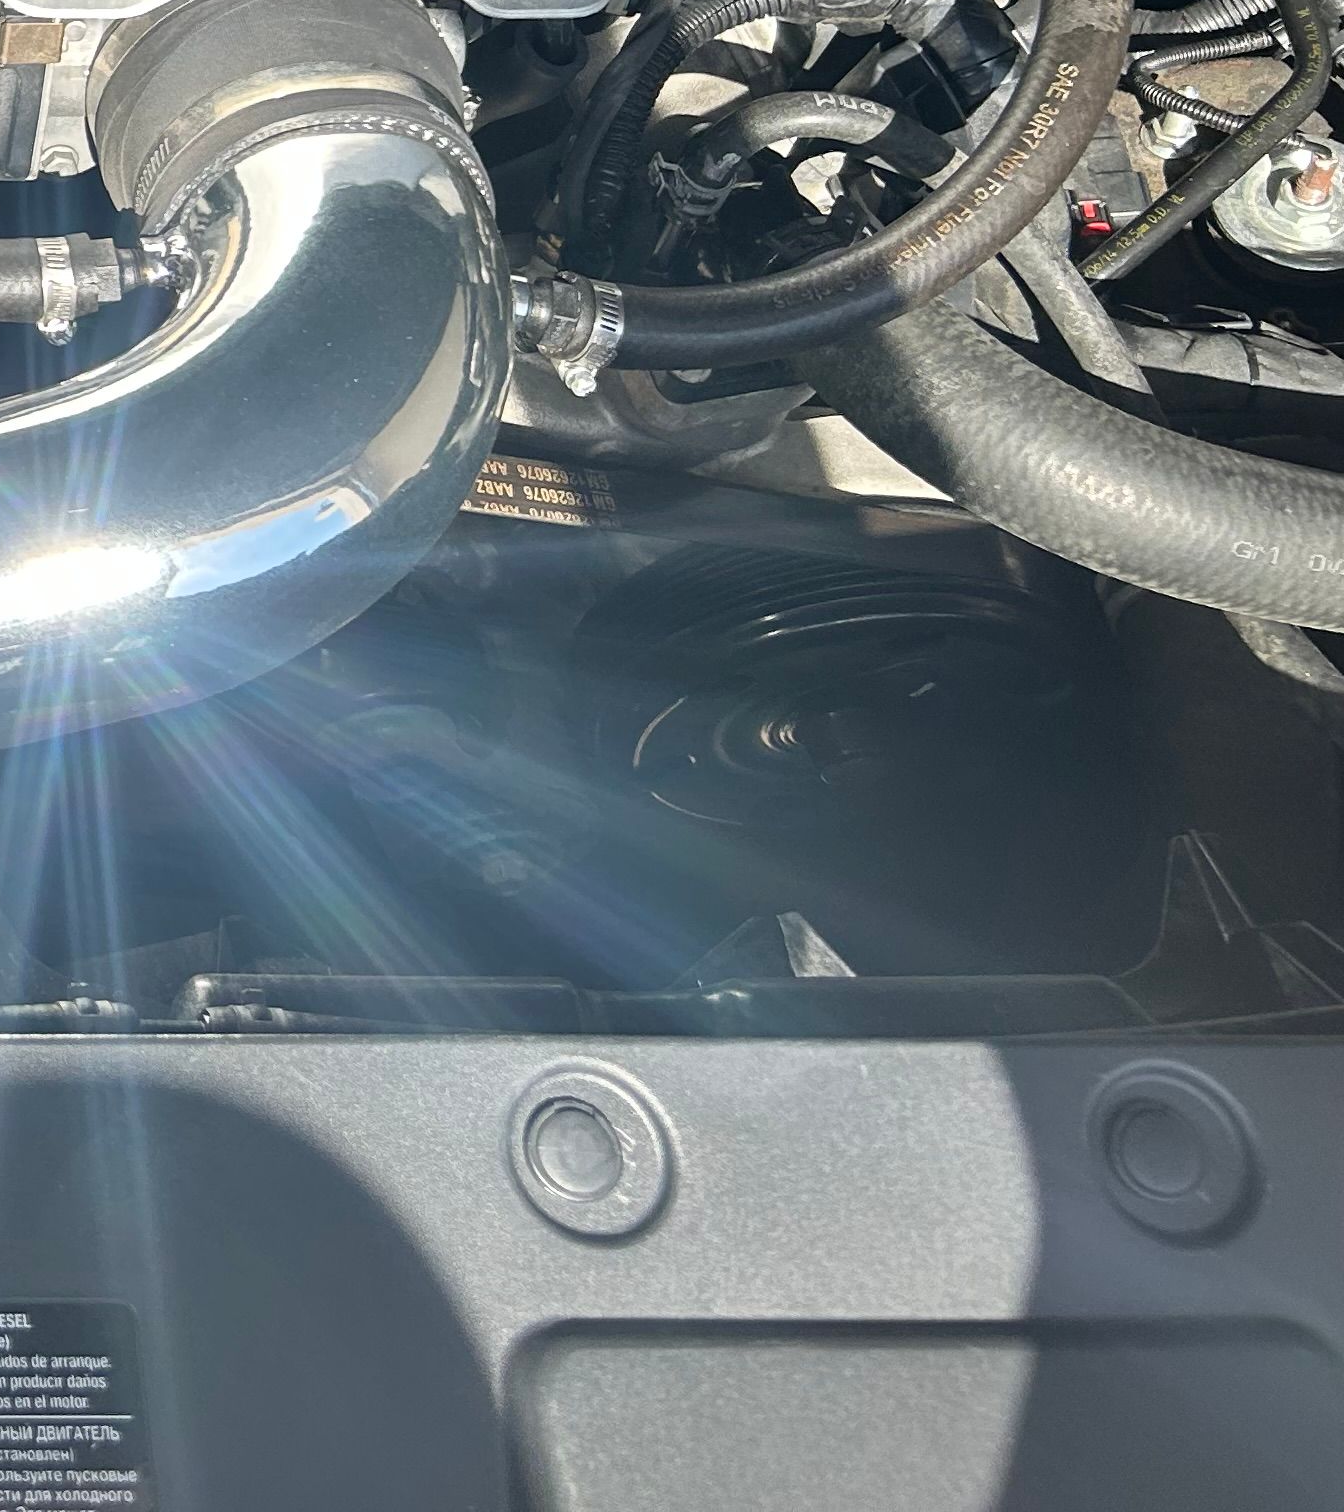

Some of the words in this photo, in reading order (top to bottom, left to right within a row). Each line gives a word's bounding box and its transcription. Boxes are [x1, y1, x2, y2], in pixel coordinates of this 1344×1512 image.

[1045, 61, 1080, 102] SAE
[1023, 101, 1060, 150] 30R7
[992, 147, 1031, 181] Not
[971, 176, 1005, 206] For
[931, 202, 976, 245] Fuel
[474, 477, 515, 498] AABZ
[522, 484, 617, 512] GM12626076
[31, 1354, 47, 1368] de
[51, 1356, 112, 1371] arranque.
[10, 1374, 63, 1391] producir
[66, 1374, 107, 1388] daños
[15, 1396, 31, 1408] en
[34, 1394, 47, 1408] el
[50, 1395, 90, 1409] motor.
[36, 1425, 121, 1443] ДВИГАТЕЛЬ
[66, 1469, 138, 1484] пусковые
[24, 1491, 51, 1504] для
[55, 1490, 135, 1504] холодного
